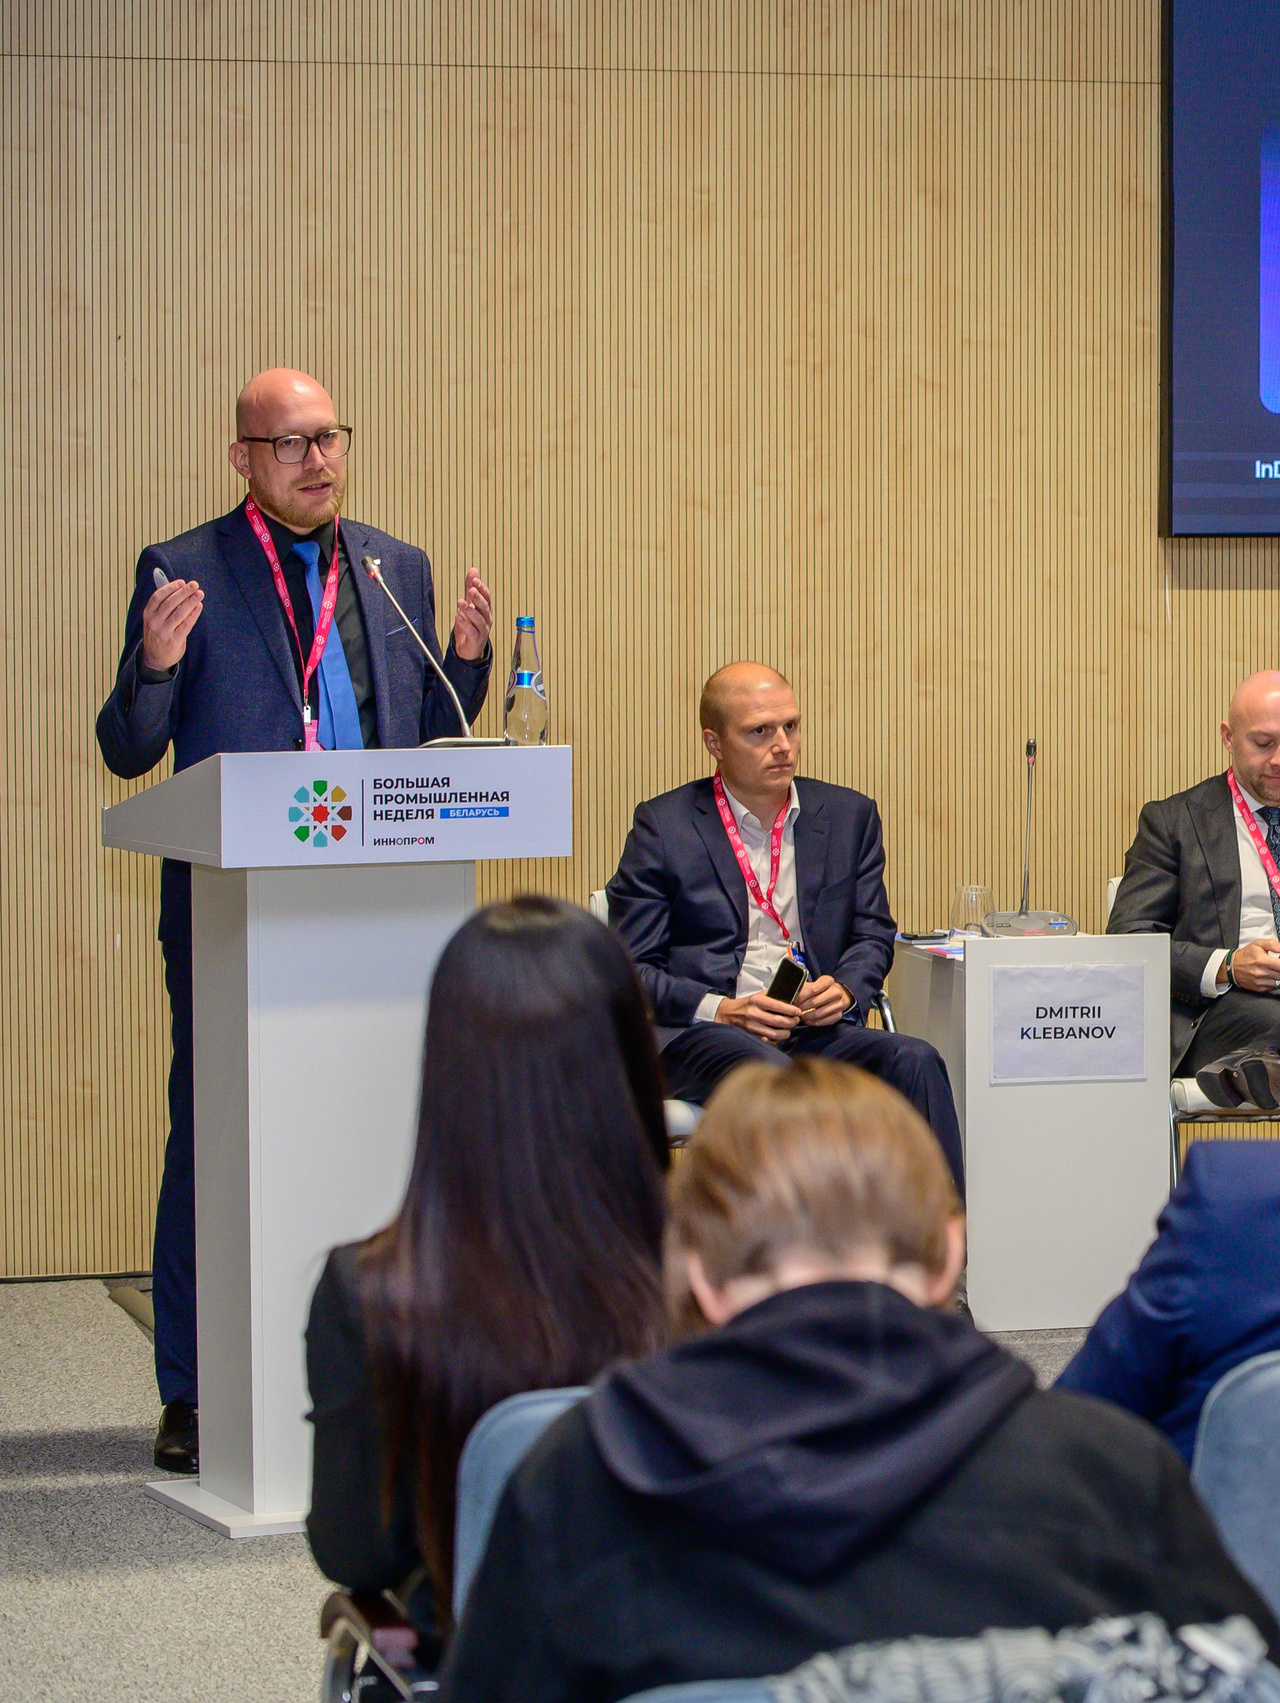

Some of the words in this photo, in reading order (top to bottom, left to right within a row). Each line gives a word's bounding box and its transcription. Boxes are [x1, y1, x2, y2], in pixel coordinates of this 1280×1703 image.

[373, 776, 451, 790] БОЛЬШАЯ
[373, 790, 510, 806] ПРОМЫШЛЕННАЯ
[373, 808, 435, 822] НЕДЕЛЯ
[449, 808, 500, 818] БЕЛАРУСЬ
[373, 836, 435, 847] ИННОПРОМ
[1036, 1006, 1101, 1019] DMITRII
[1020, 1026, 1116, 1040] KLEBANOV
